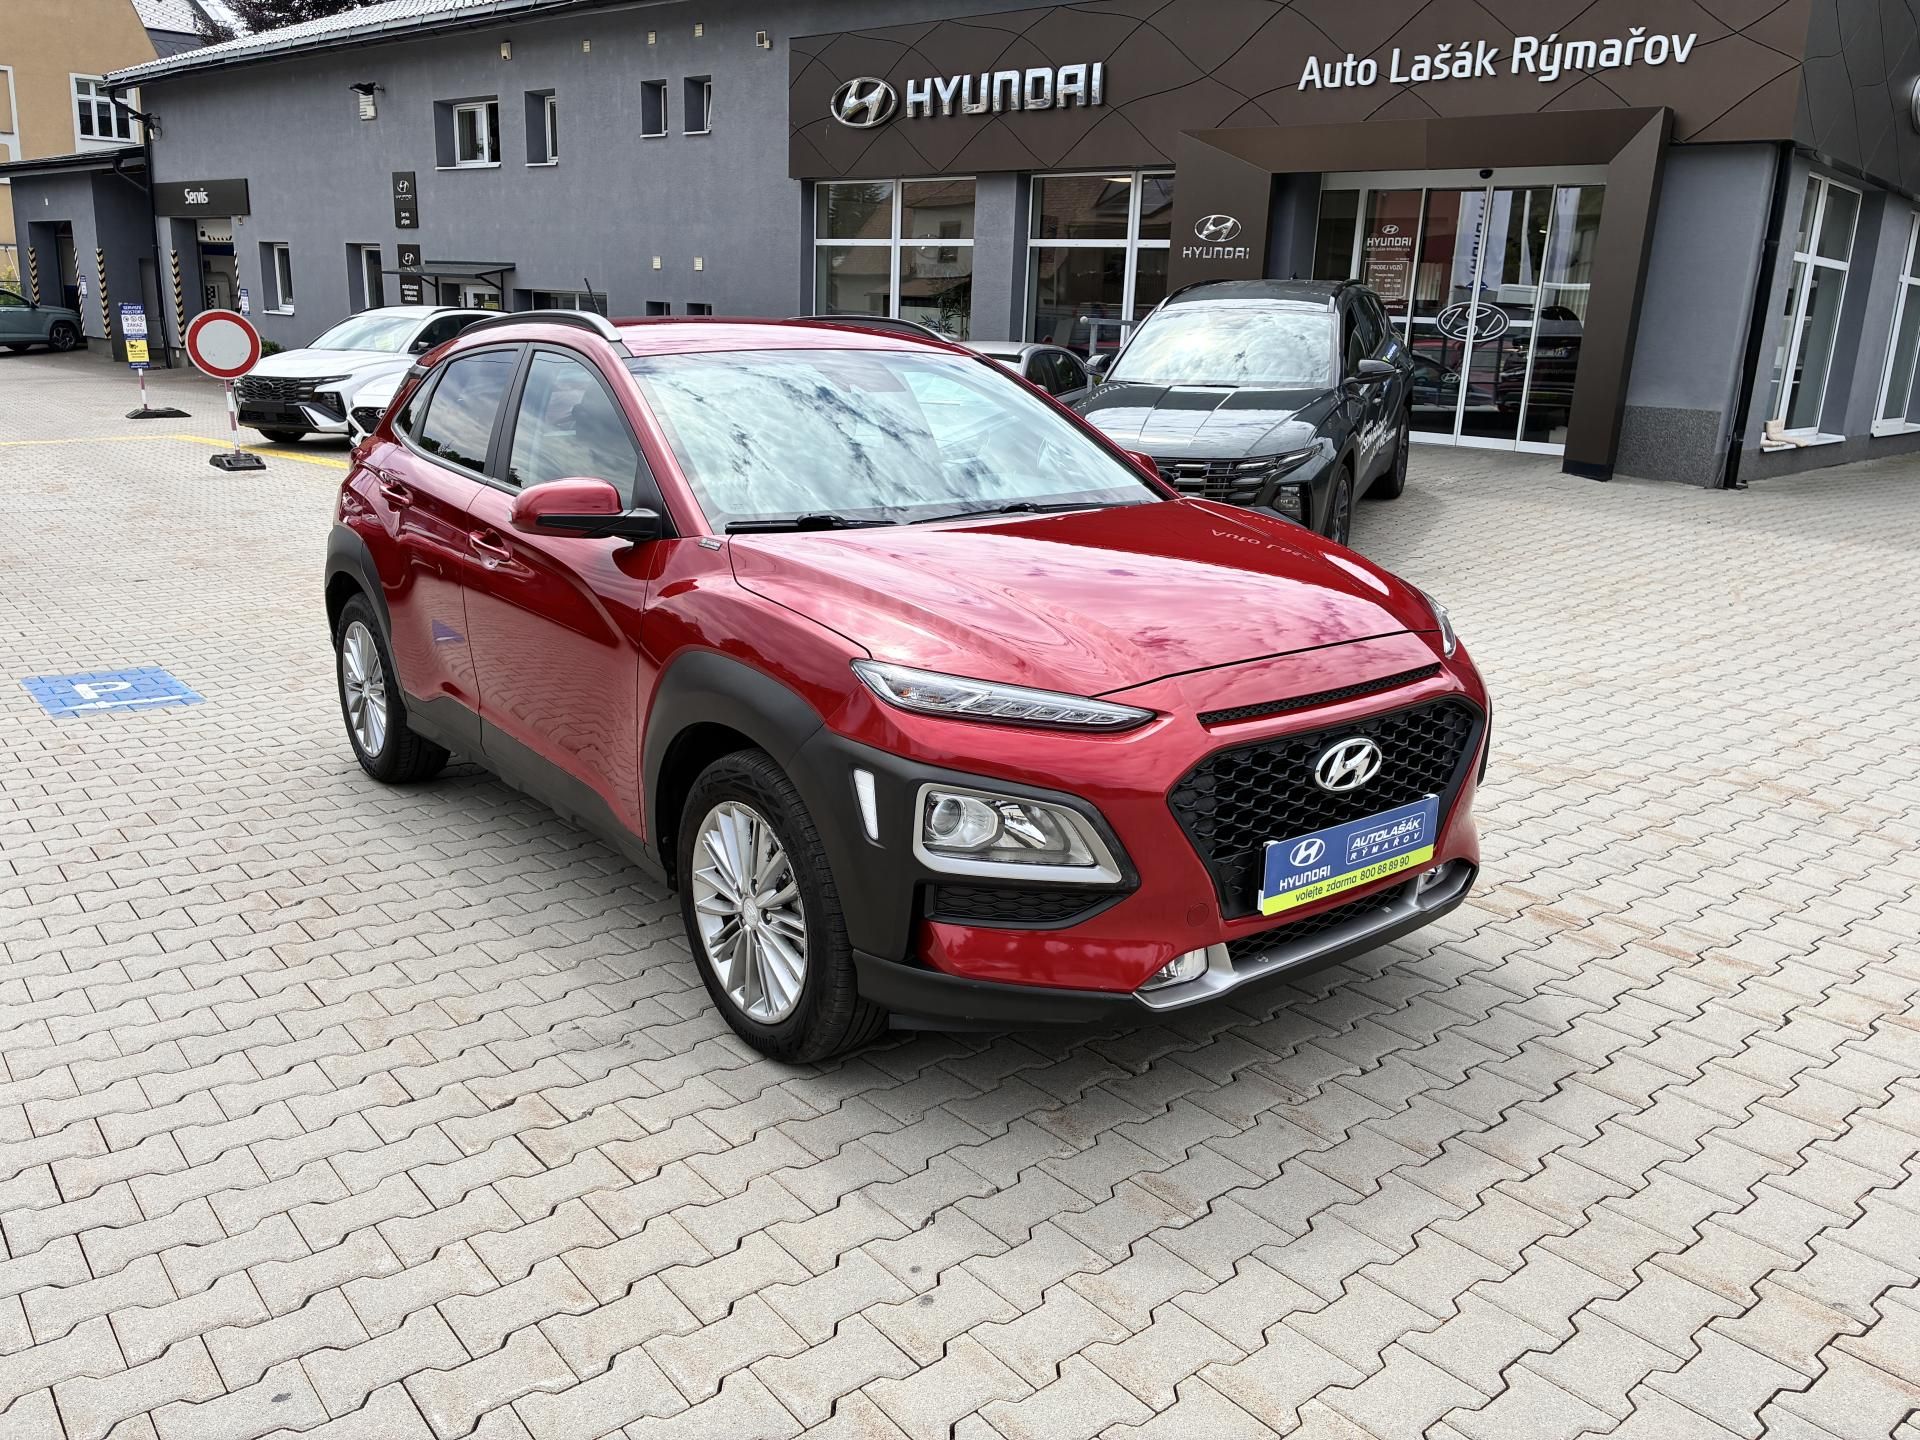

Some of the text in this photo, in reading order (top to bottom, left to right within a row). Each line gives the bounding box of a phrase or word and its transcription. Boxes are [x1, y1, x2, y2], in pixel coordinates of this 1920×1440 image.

[1297, 27, 1697, 91] Auto Lašák Rýmařov
[906, 62, 1104, 118] HYUNDAI
[184, 187, 208, 204] Servis
[1182, 246, 1250, 259] HYUNDAI
[1367, 237, 1411, 247] HYUNDAI
[74, 681, 132, 700] P
[1350, 832, 1420, 861] RÝMAŘOV
[1351, 817, 1421, 850] AUTOLAŠÁK
[1279, 865, 1331, 891] HYUNDAI
[1295, 855, 1410, 902] volejte zdarma 800 88 89 90
